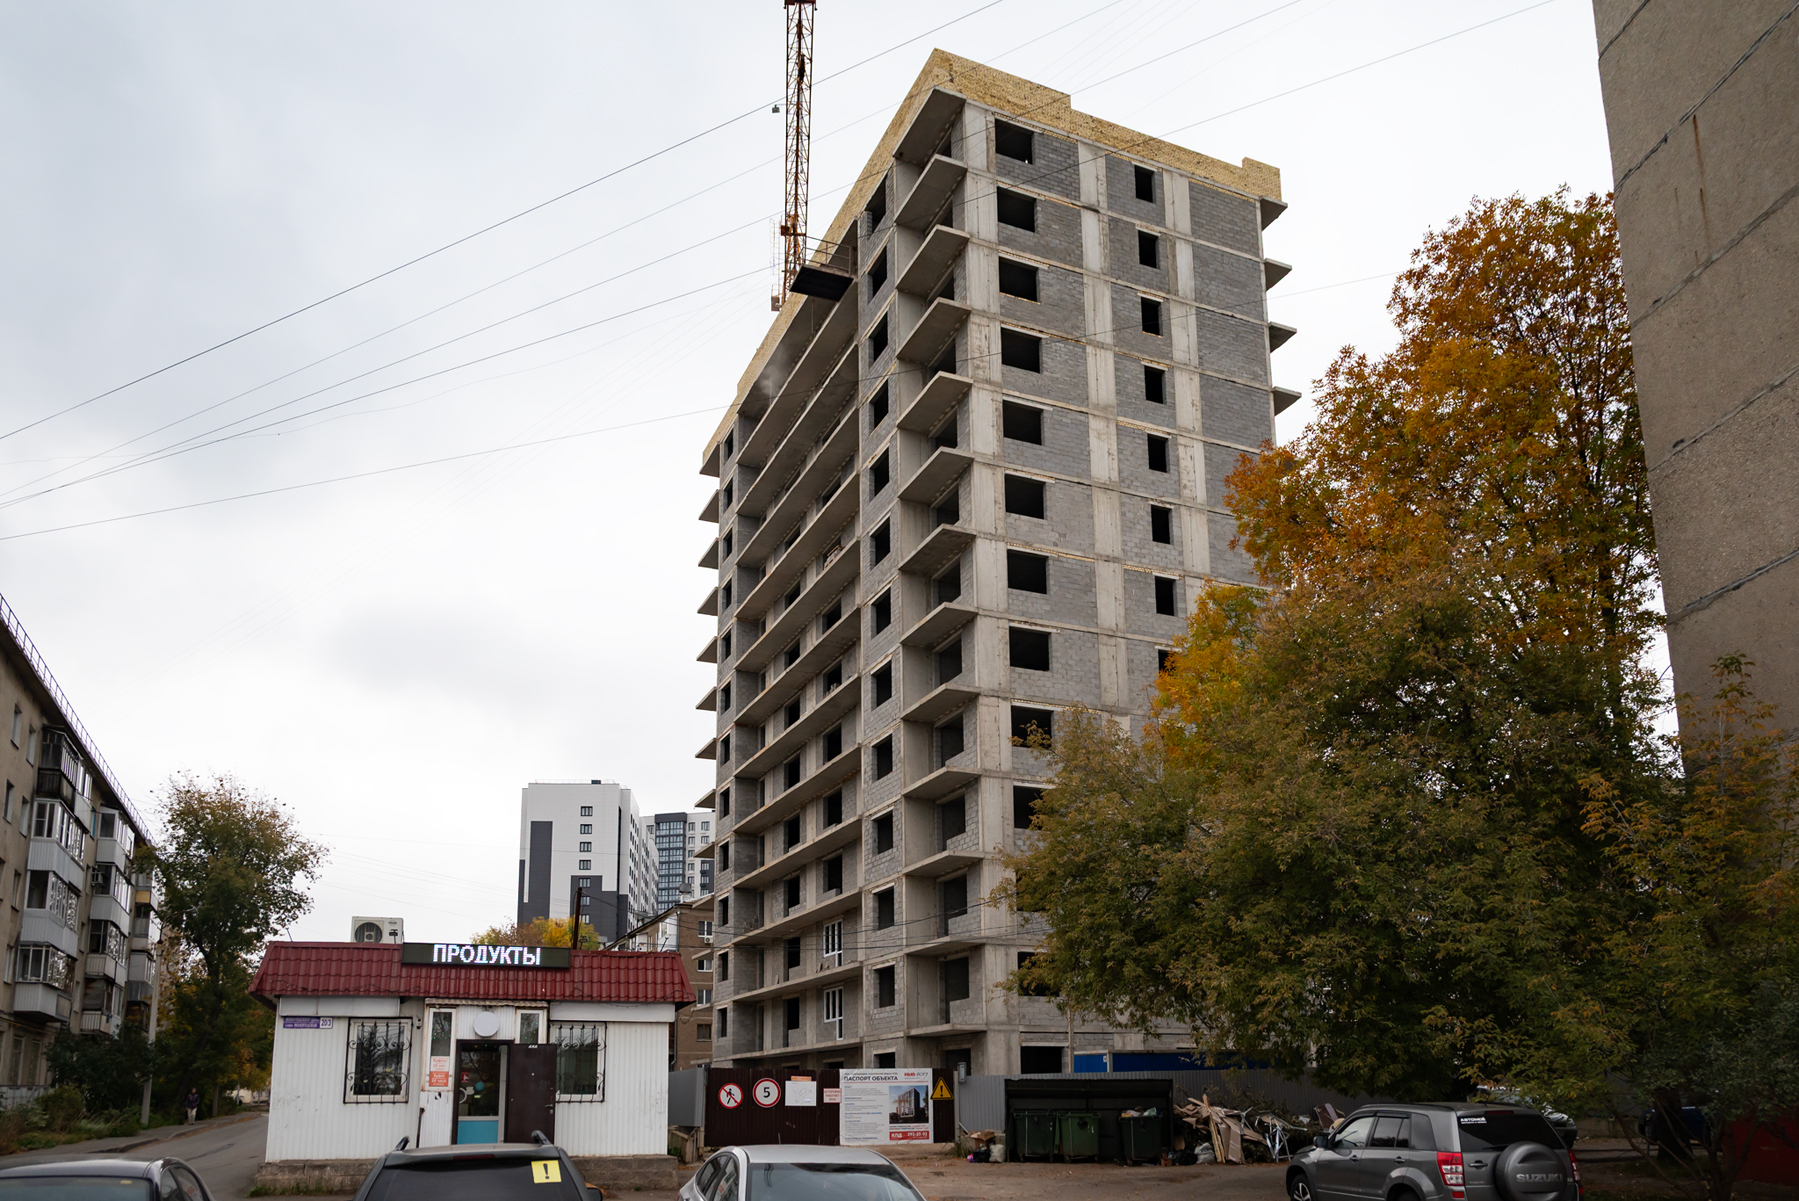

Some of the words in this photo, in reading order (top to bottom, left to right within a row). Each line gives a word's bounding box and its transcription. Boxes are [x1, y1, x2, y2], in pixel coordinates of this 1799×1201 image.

[433, 944, 541, 965] ПРОДУКТЫ
[763, 1087, 771, 1098] 5
[1516, 1173, 1563, 1182] SUZUKI
